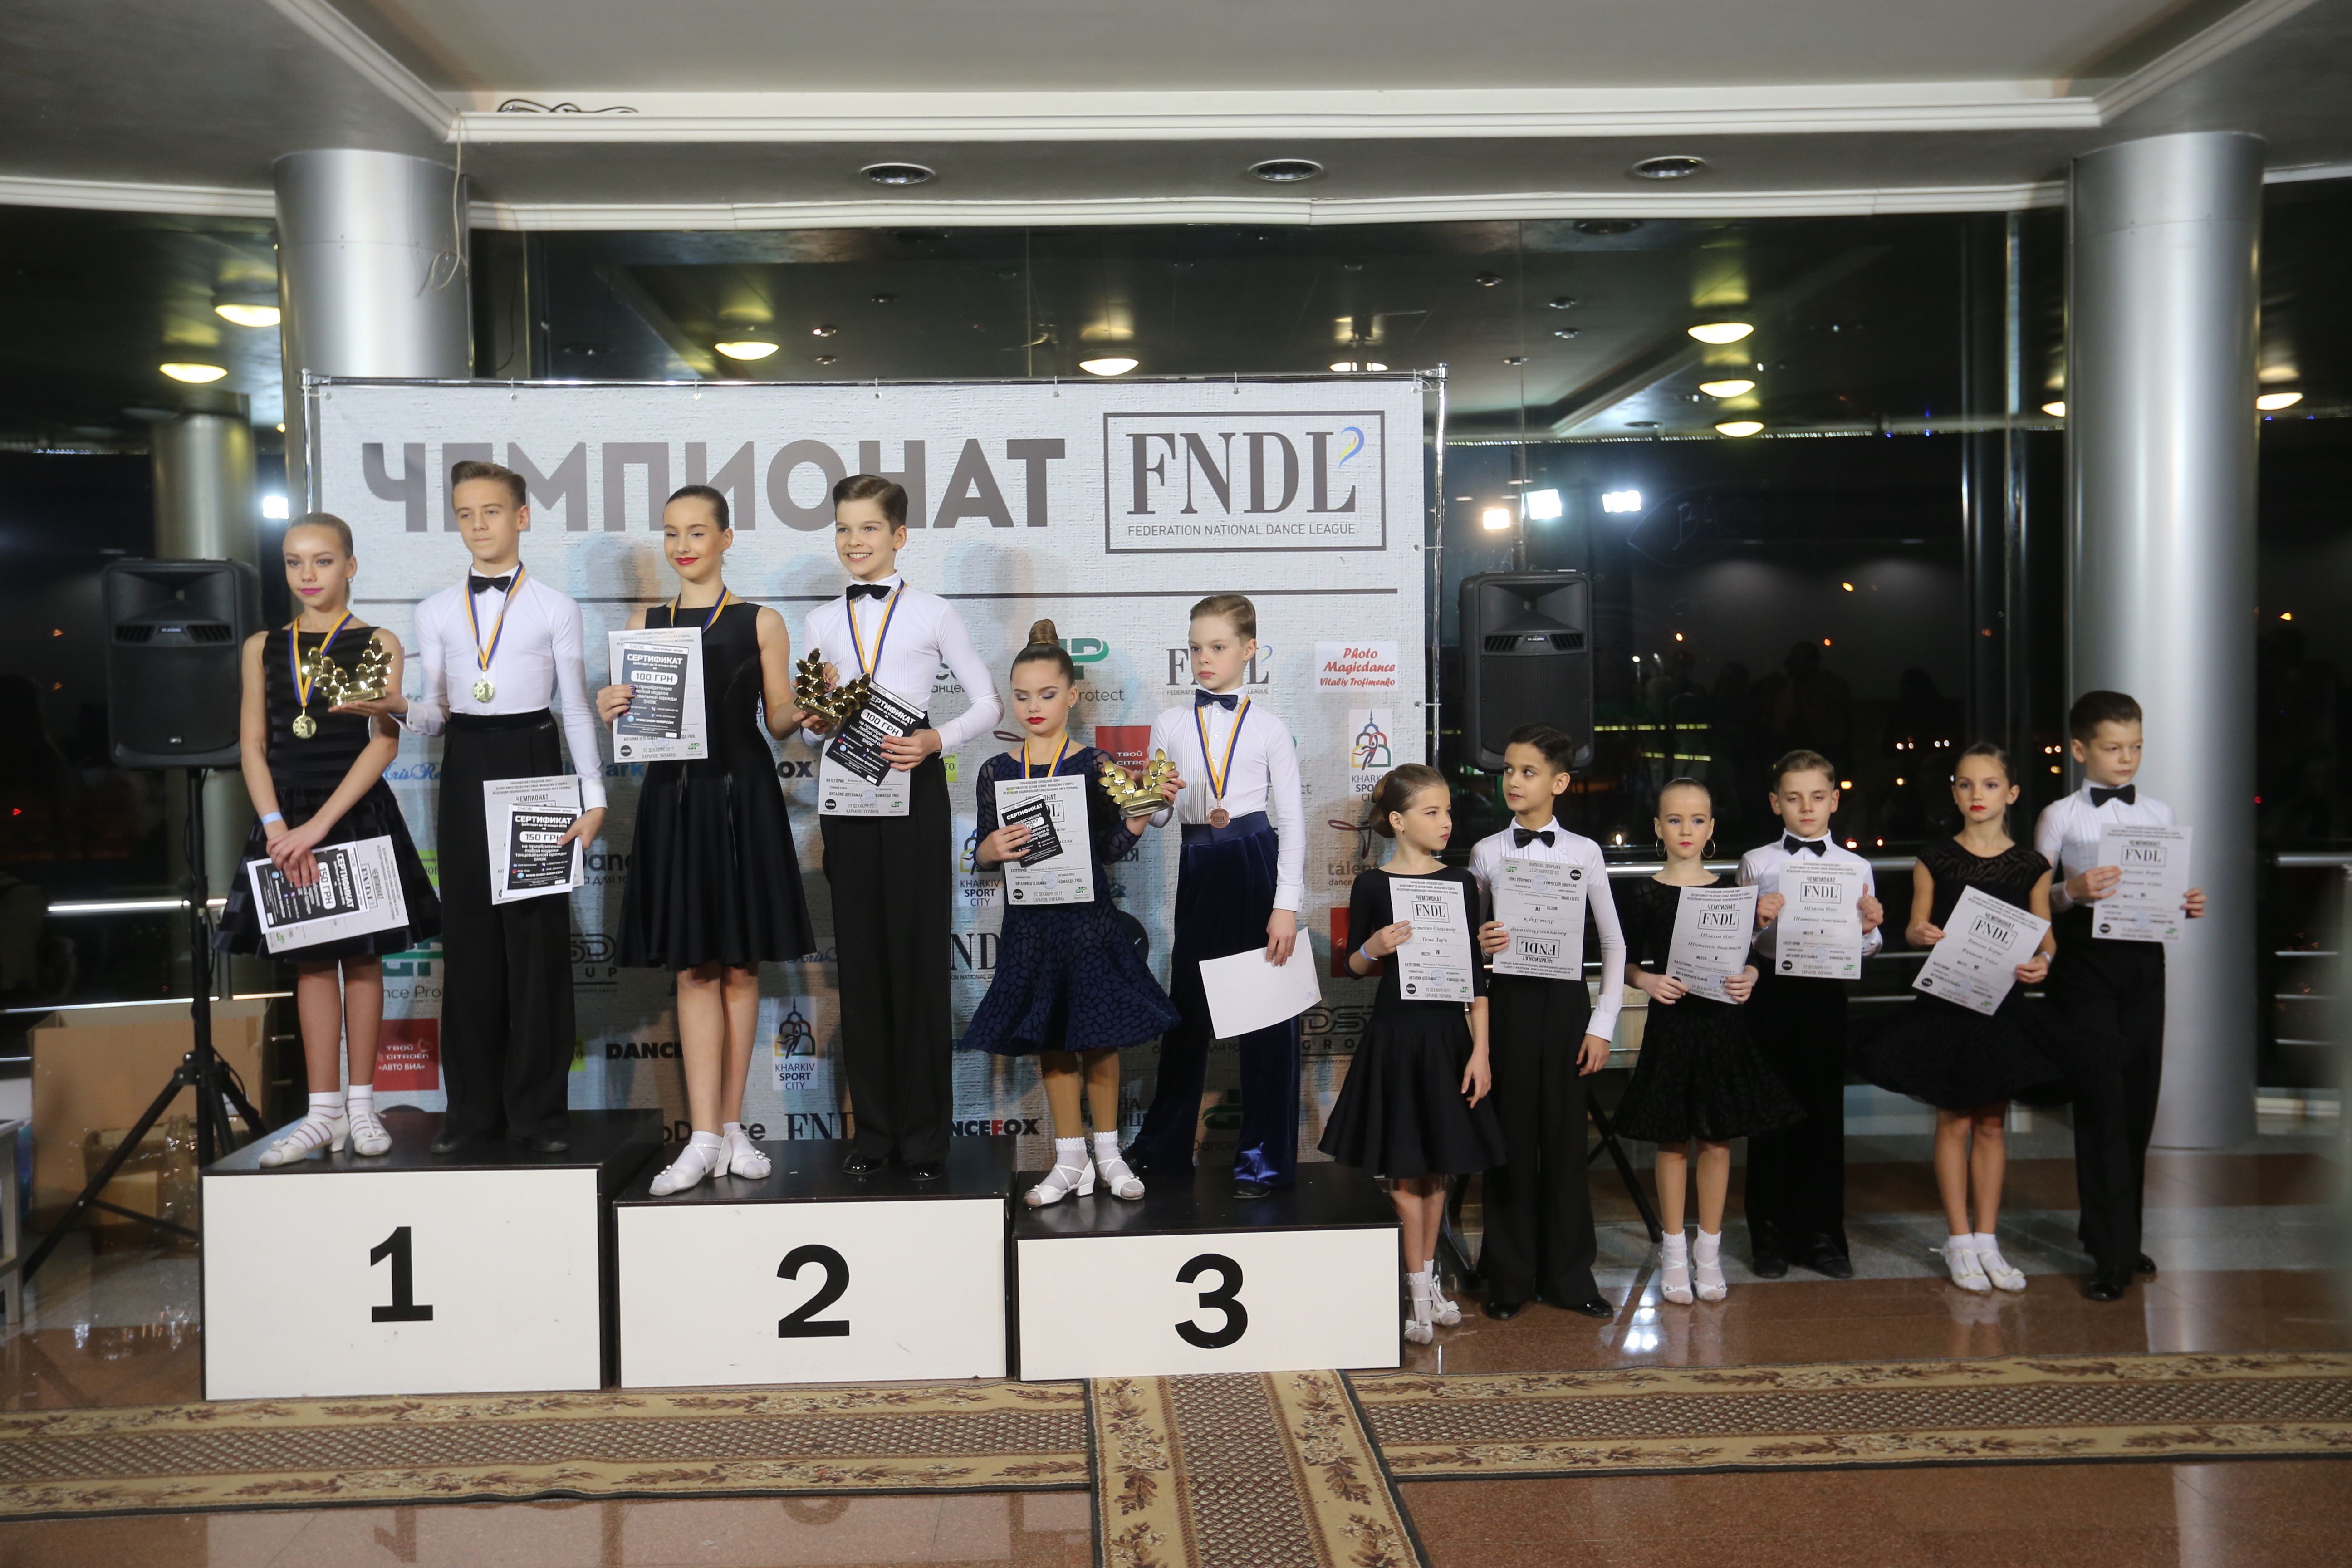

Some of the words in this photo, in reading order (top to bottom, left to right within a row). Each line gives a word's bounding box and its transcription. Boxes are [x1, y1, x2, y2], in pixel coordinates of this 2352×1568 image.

[1126, 431, 1356, 515] FNDL
[1128, 524, 1201, 537] FEDERATION
[1204, 524, 1263, 536] NATIONAL
[1266, 523, 1306, 535] DANCE
[1309, 523, 1355, 535] LEAGUE
[627, 654, 683, 665] СЕРТИФИКАТ
[1343, 647, 1378, 660] Photo
[1166, 648, 1269, 685] FL
[1323, 660, 1396, 674] Magicdance
[655, 674, 673, 682] ГРН
[1320, 677, 1348, 687] Vitaliy
[1349, 677, 1396, 687] Trofimenko
[1079, 689, 1124, 701] rotect
[866, 712, 881, 725] 100
[881, 723, 899, 736] ГРН
[516, 794, 549, 802] ЧЕМПИОНАТ
[1007, 803, 1043, 820] СЕРТИФИКАТ
[515, 815, 572, 824] СЕРТИФИКАТ
[2125, 848, 2161, 862] FNDL
[322, 886, 333, 904] ГРН
[1804, 885, 1838, 898] FNDL
[970, 898, 990, 906] CITY
[1416, 904, 1446, 917] FNDL
[1702, 913, 1736, 925] FNDL
[1975, 919, 2010, 945] FNDL
[1521, 941, 1556, 956] FNDL
[1523, 956, 1553, 964] ЧЕМПИОНАТ
[775, 1063, 815, 1072] KHARKIV
[779, 1073, 811, 1081] SPORT
[785, 1082, 805, 1090] CITY
[370, 1226, 434, 1322] 1
[776, 1245, 850, 1338] 2
[1175, 1253, 1248, 1350] 3
